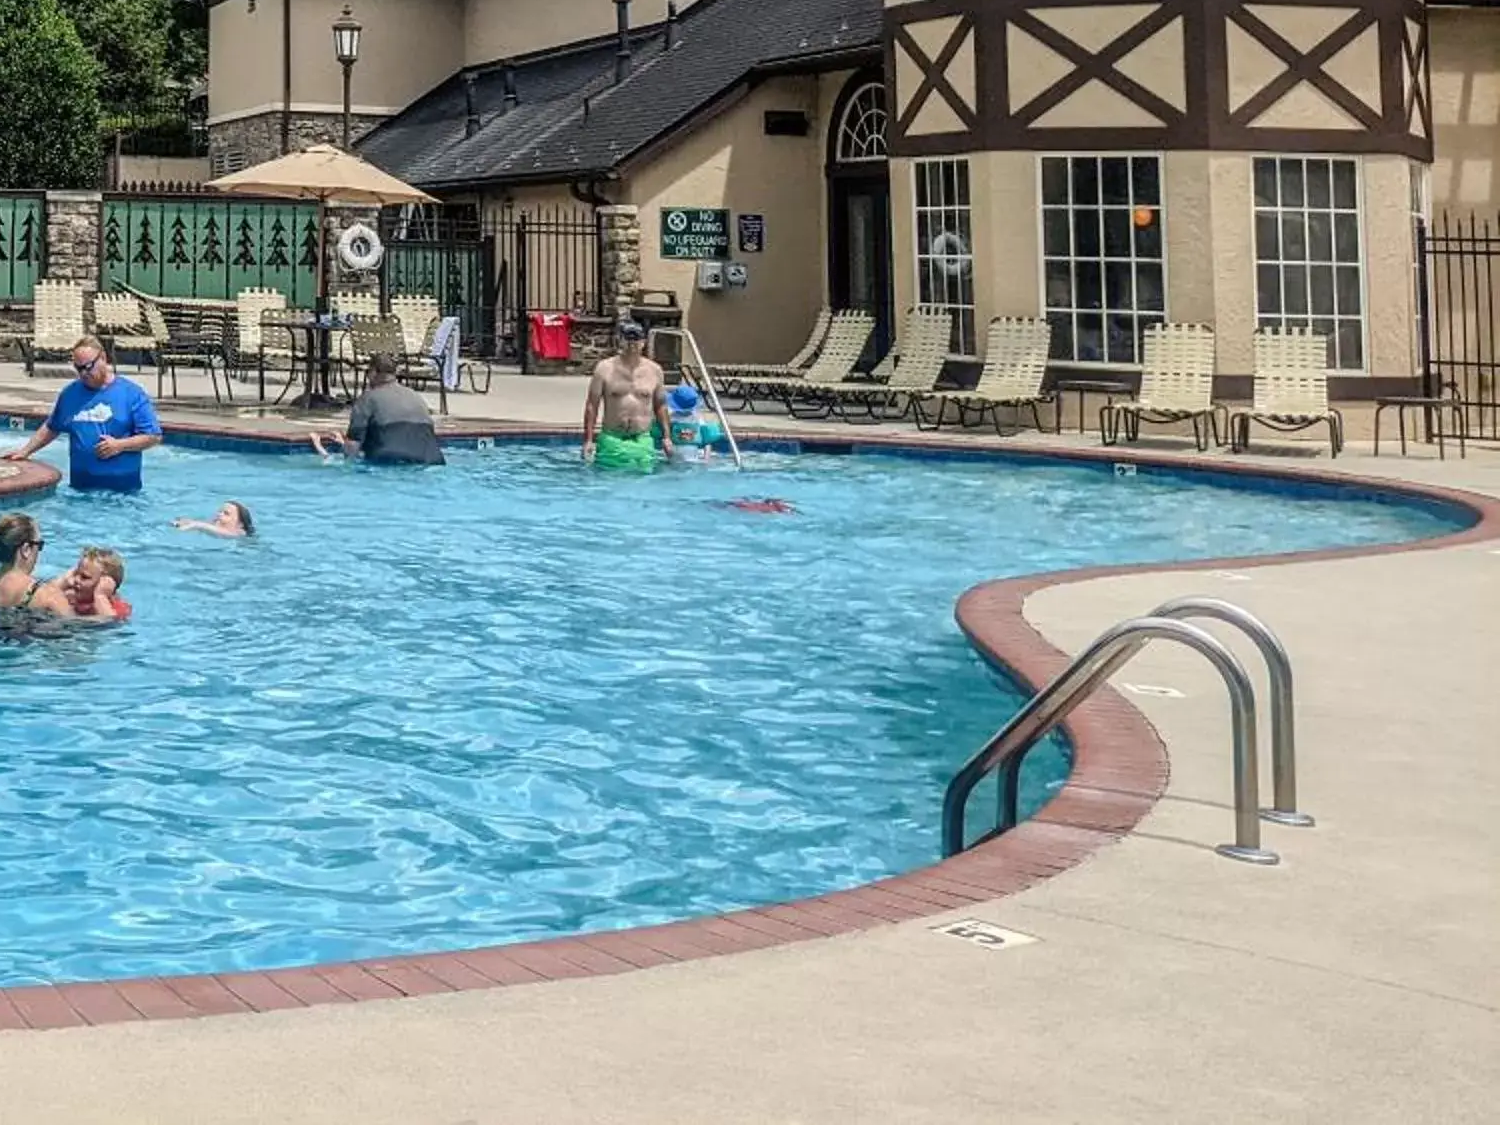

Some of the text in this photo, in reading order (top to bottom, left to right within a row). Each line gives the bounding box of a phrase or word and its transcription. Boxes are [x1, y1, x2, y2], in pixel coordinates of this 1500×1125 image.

[699, 210, 715, 221] NO
[691, 222, 723, 232] DIVING
[663, 234, 728, 245] NO LIFEGUARD
[675, 246, 717, 257] ON DUTY
